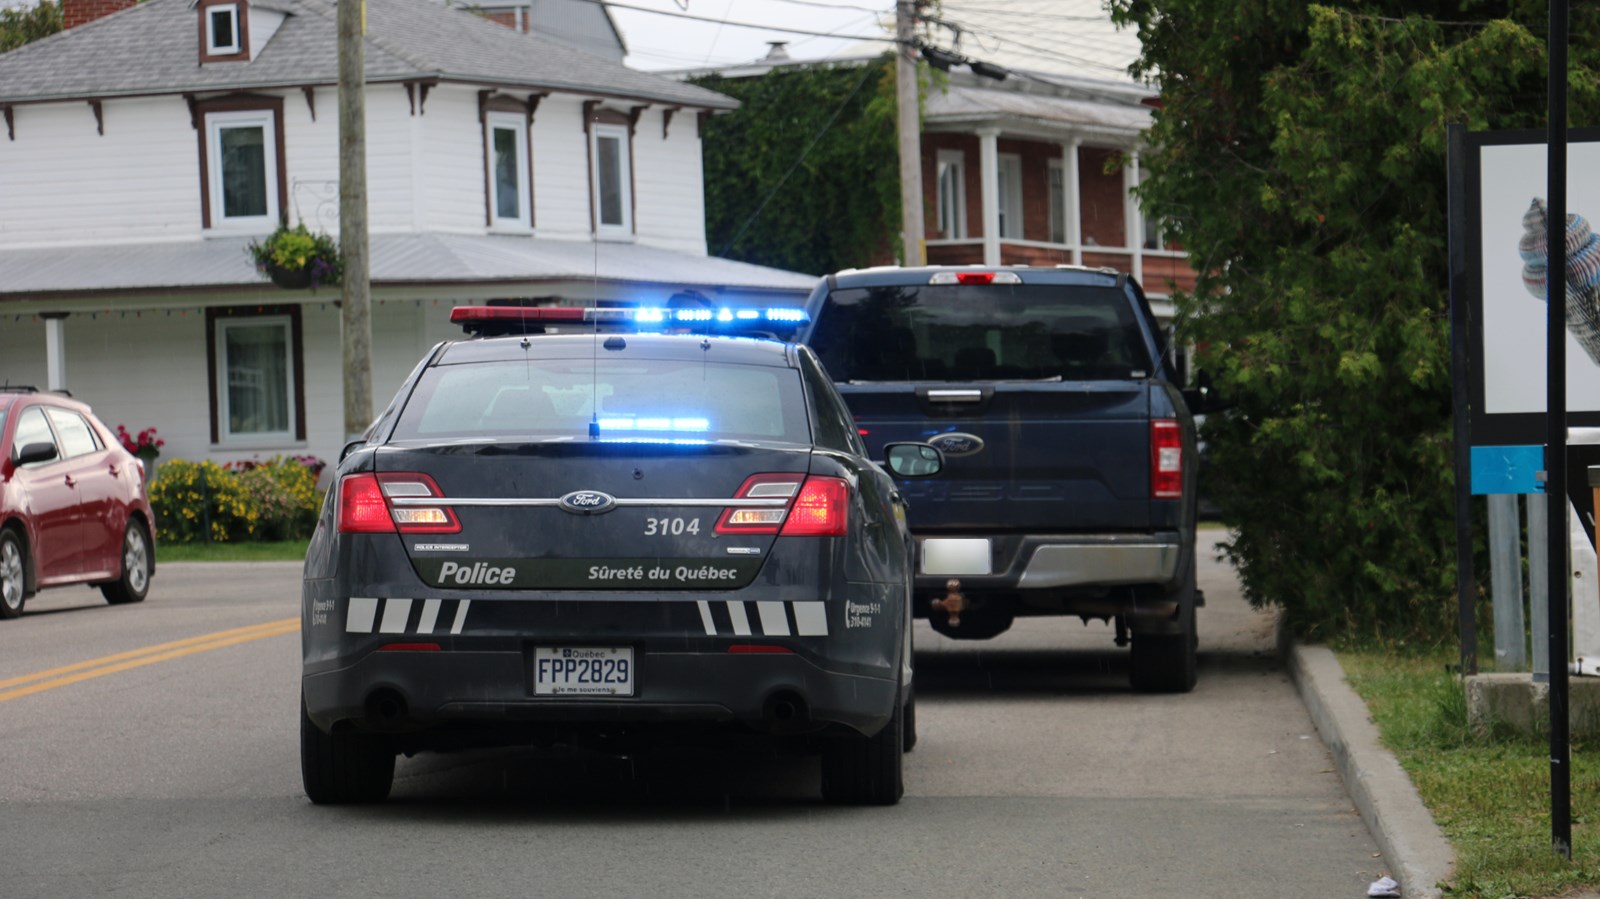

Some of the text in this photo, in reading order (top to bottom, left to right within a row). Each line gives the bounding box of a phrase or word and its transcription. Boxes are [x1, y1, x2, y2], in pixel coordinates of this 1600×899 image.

[943, 438, 970, 452] Ford
[573, 494, 600, 506] Ford
[644, 517, 700, 536] 3104
[438, 561, 516, 584] Police
[588, 565, 737, 582] Sûreté du Québec
[850, 602, 870, 616] Urgence
[572, 650, 605, 658] Québec
[538, 659, 629, 684] FPP2829
